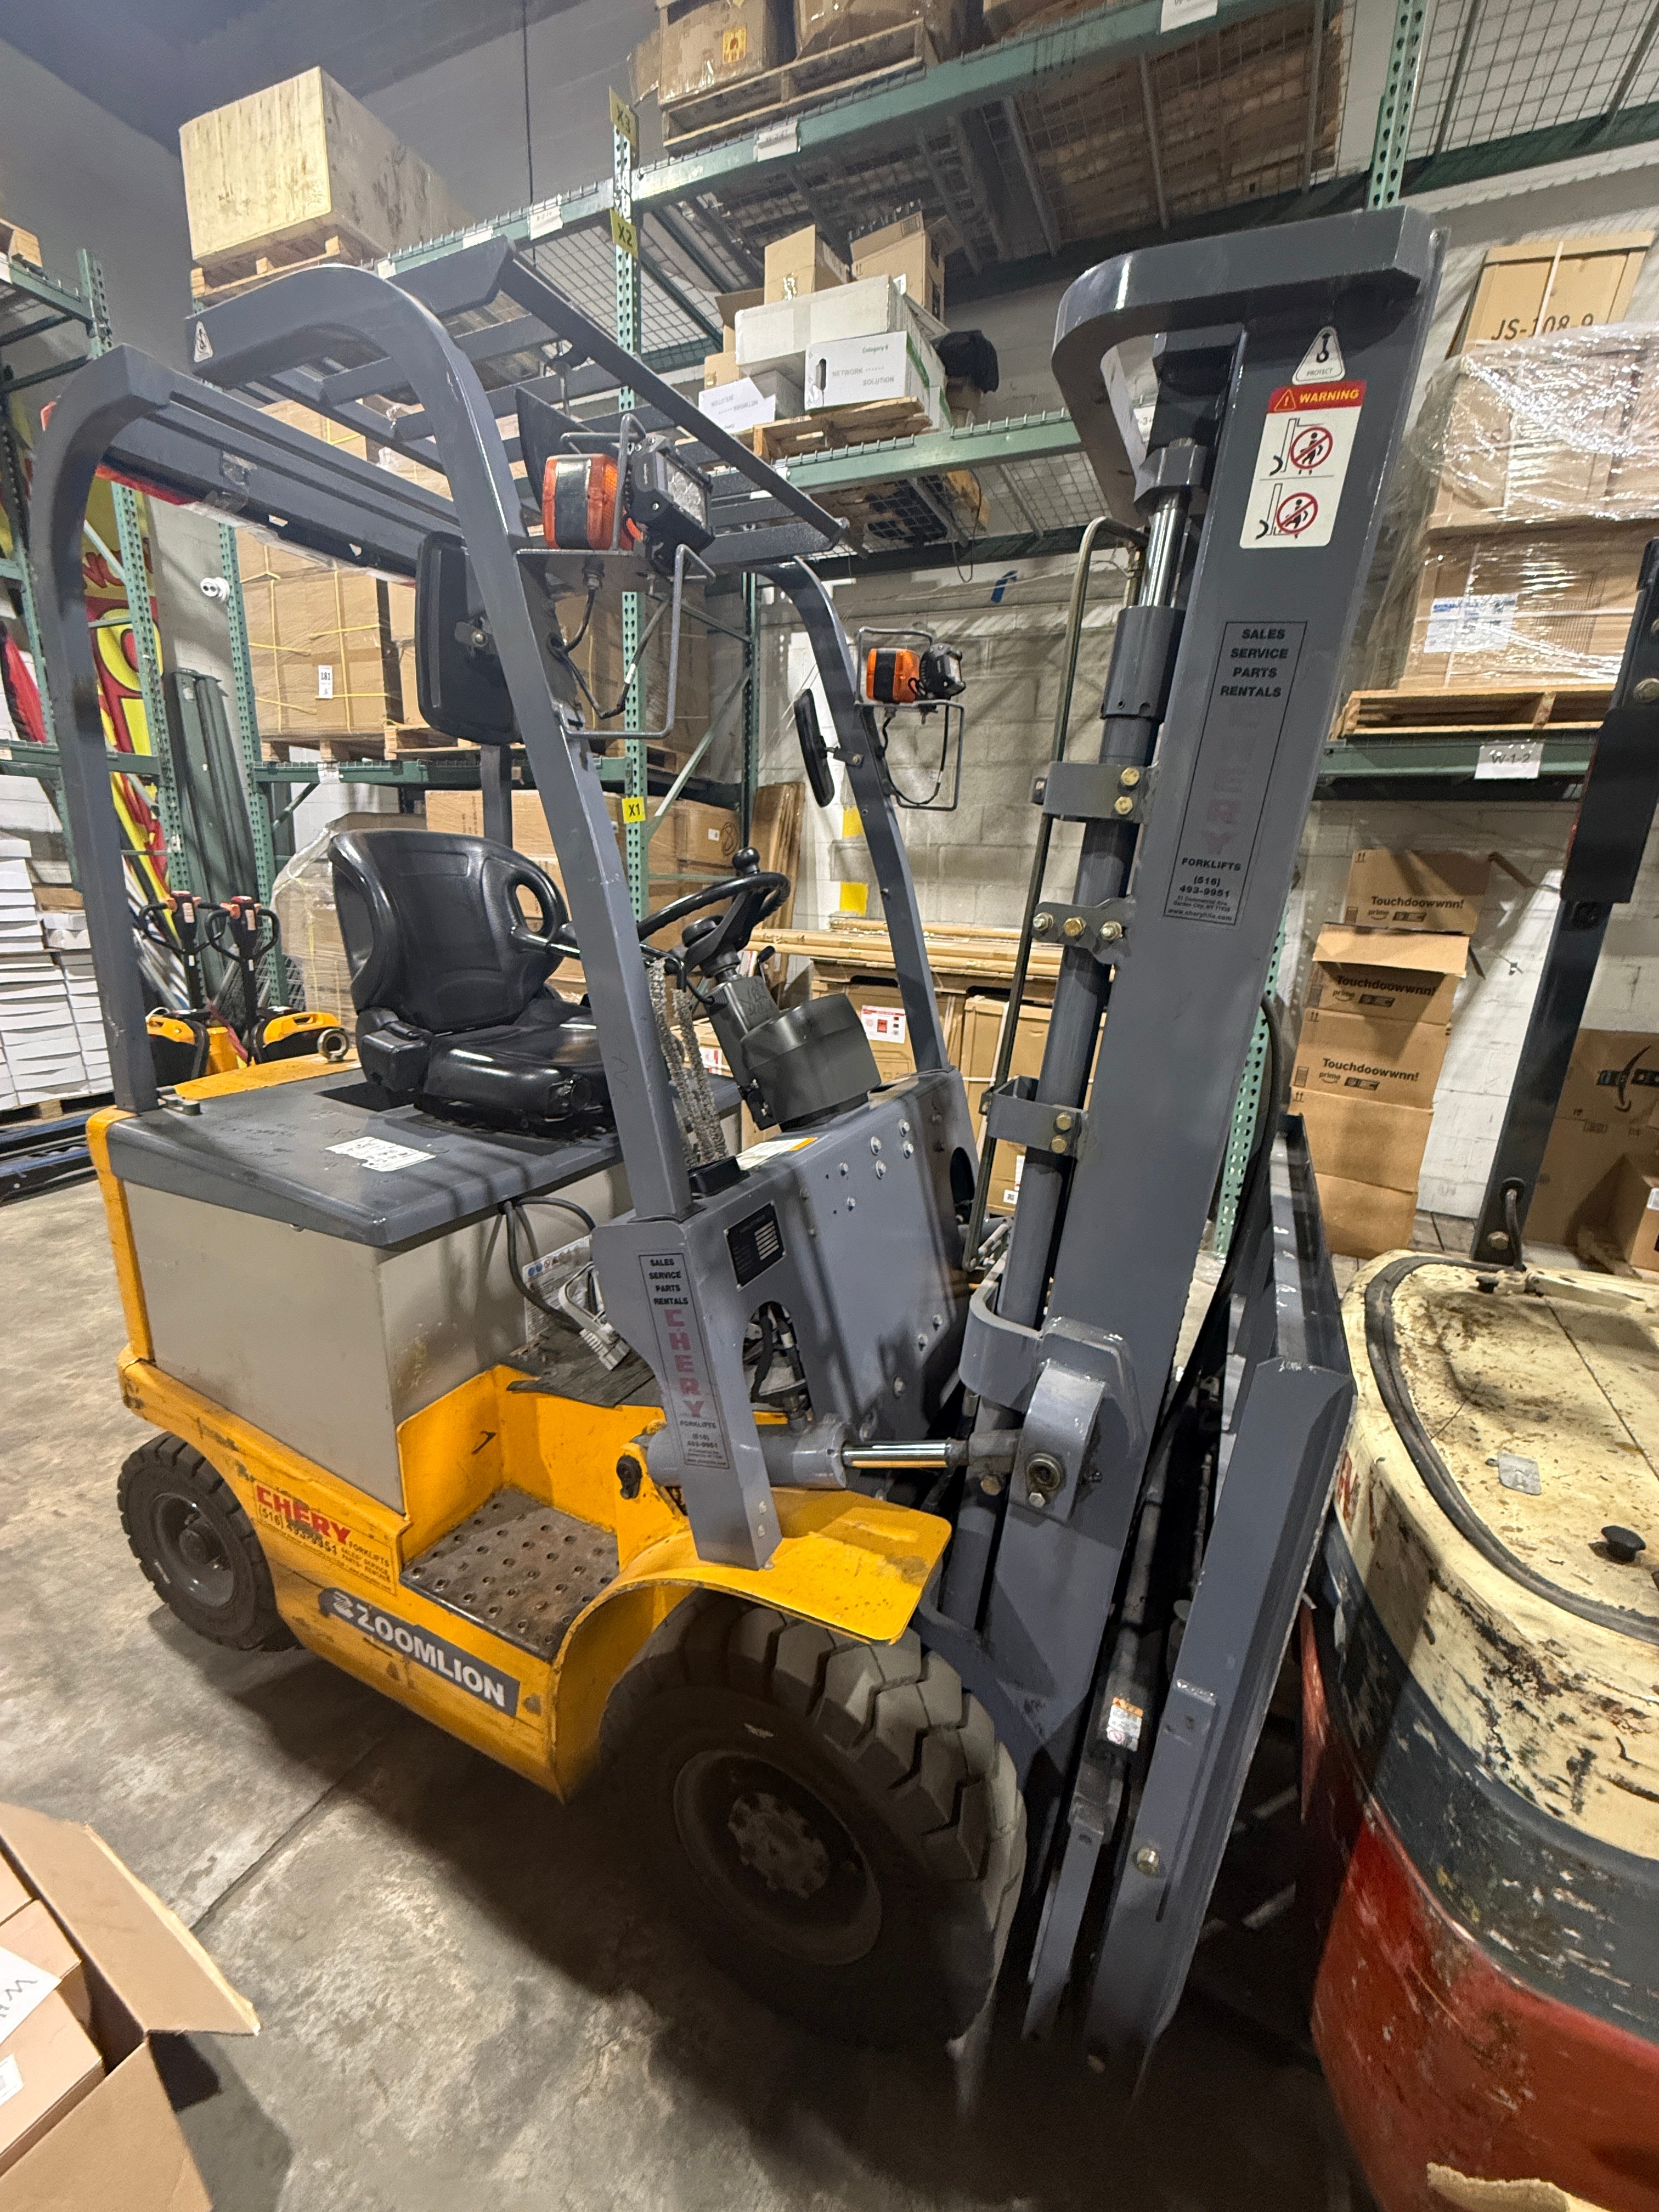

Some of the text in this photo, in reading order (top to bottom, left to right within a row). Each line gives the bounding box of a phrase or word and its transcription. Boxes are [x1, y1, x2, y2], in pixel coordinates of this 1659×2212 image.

[617, 104, 631, 134] X3
[618, 222, 633, 247] X2
[832, 368, 863, 377] NETWORK
[1306, 368, 1334, 377] PROTECT
[862, 376, 894, 386] SOLUTION
[1299, 387, 1359, 404] WARNING
[1242, 629, 1285, 640] SALES
[1230, 647, 1289, 659] SERVICE
[1233, 667, 1278, 678] PARTS
[1220, 686, 1282, 698] RENTALS
[1492, 753, 1531, 764] W-1-2
[628, 803, 640, 817] X1
[1181, 857, 1242, 871] FORKLIFTS
[1193, 875, 1221, 888] (516)
[1180, 885, 1231, 898] 493-9951
[1371, 895, 1464, 909] Touchdoowwnn!
[1336, 975, 1436, 997] Touchdoowwnn!
[1323, 1058, 1420, 1081] Touchdoowwnn!
[649, 1271, 681, 1279] SERVICE
[664, 1309, 705, 1418] CHERY
[256, 1485, 351, 1545] CHERY
[349, 1541, 390, 1567] FORKLIFTS
[357, 1604, 505, 1708] ZOOMLION
